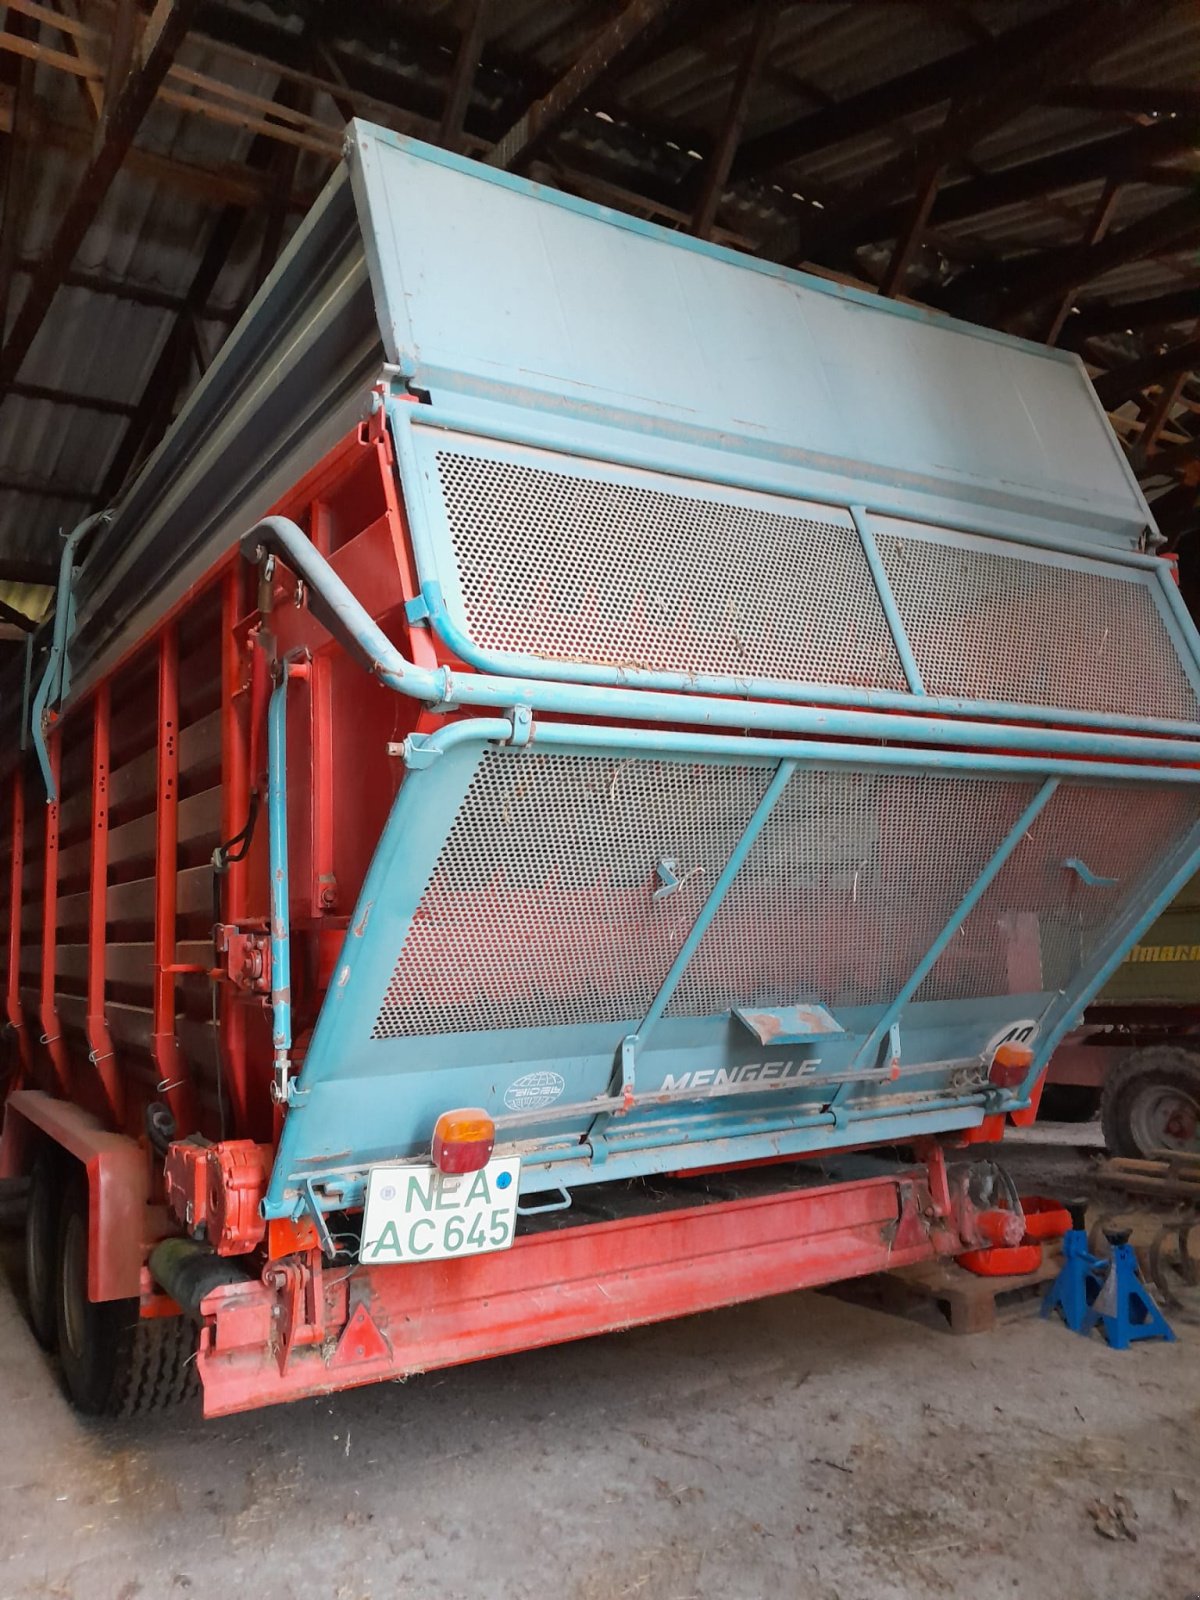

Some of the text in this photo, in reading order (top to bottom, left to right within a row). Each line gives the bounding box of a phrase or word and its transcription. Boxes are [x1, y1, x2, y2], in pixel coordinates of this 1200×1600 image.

[659, 1058, 822, 1091] MENGELE
[405, 1169, 492, 1213] NEA
[371, 1208, 511, 1258] AC 645
